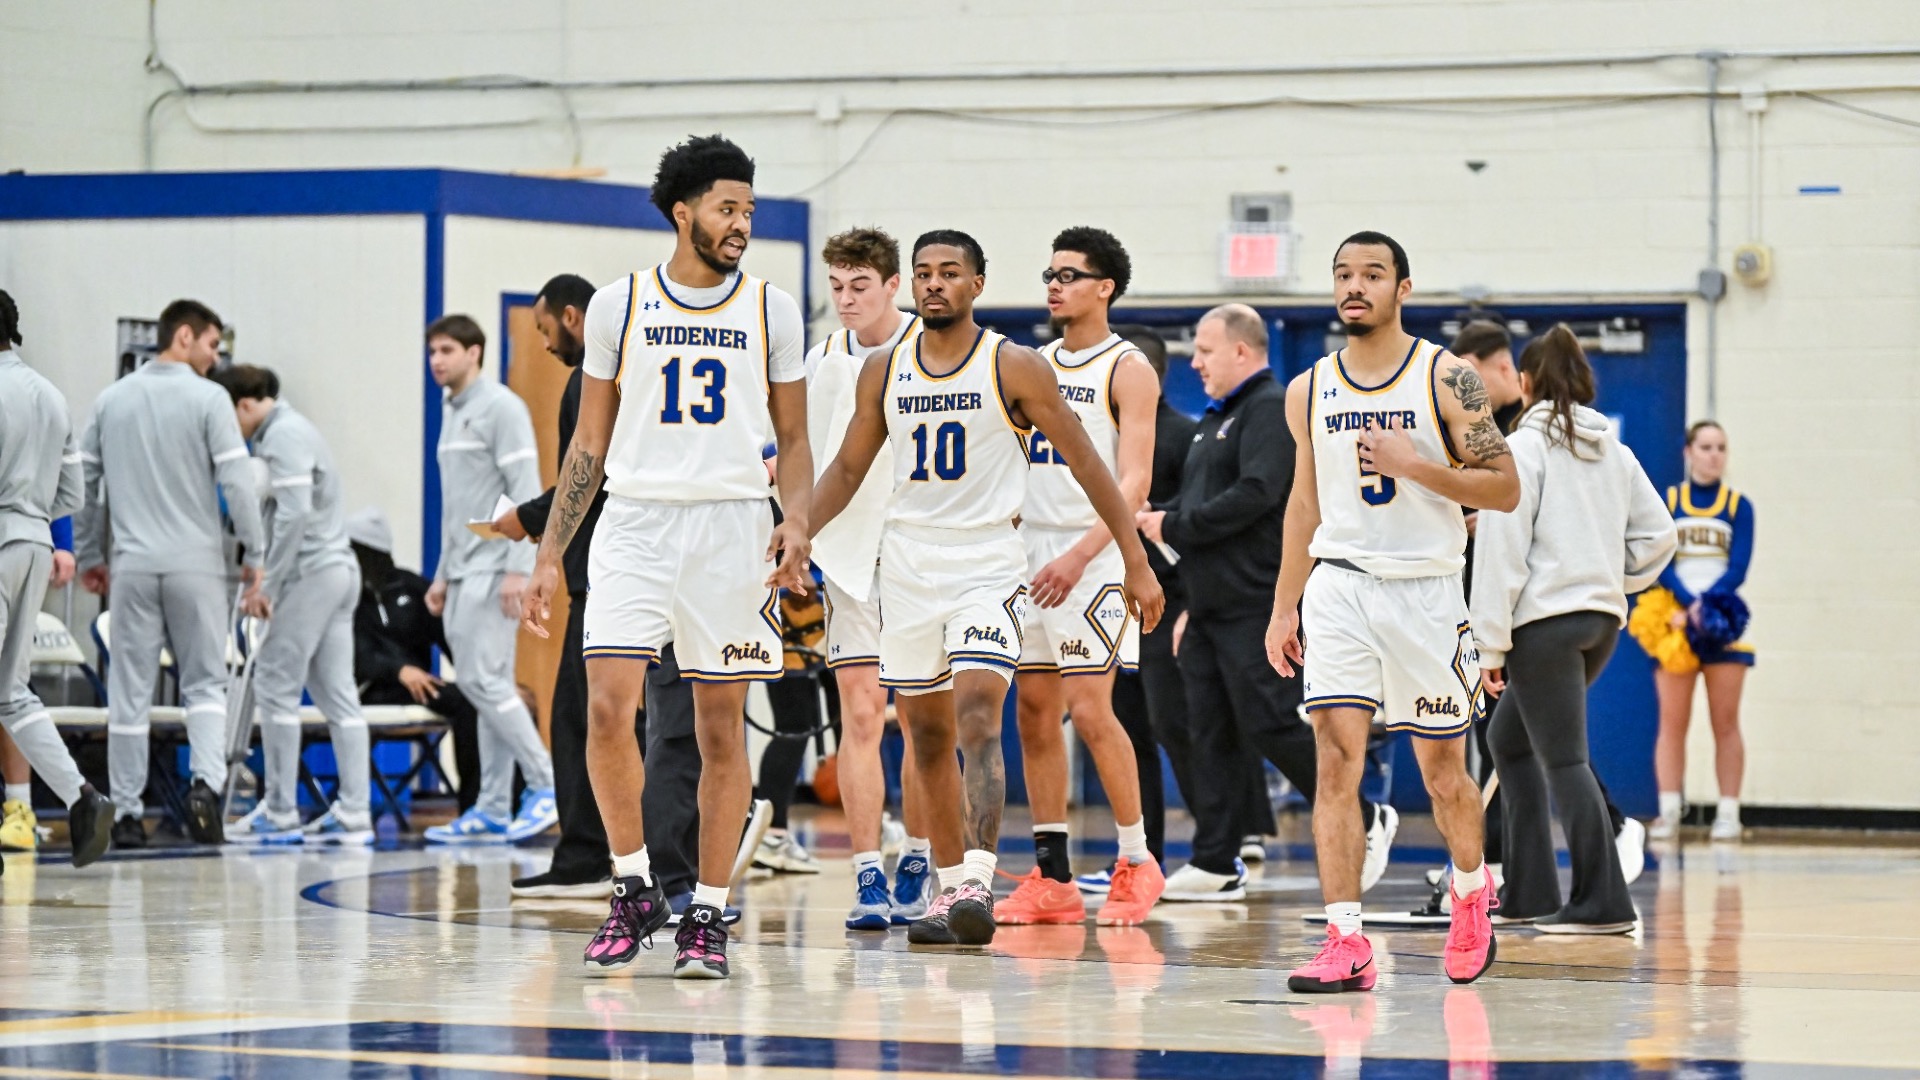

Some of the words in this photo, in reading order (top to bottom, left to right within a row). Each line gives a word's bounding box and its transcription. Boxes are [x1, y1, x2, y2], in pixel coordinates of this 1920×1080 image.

[644, 326, 748, 350] WIDENER
[660, 357, 727, 425] 13
[897, 392, 982, 415] WIDENER
[910, 421, 966, 481] 10
[1356, 440, 1397, 507] 5
[963, 625, 1008, 650] Pride
[721, 641, 771, 666] Pride
[1415, 696, 1460, 718] Pride
